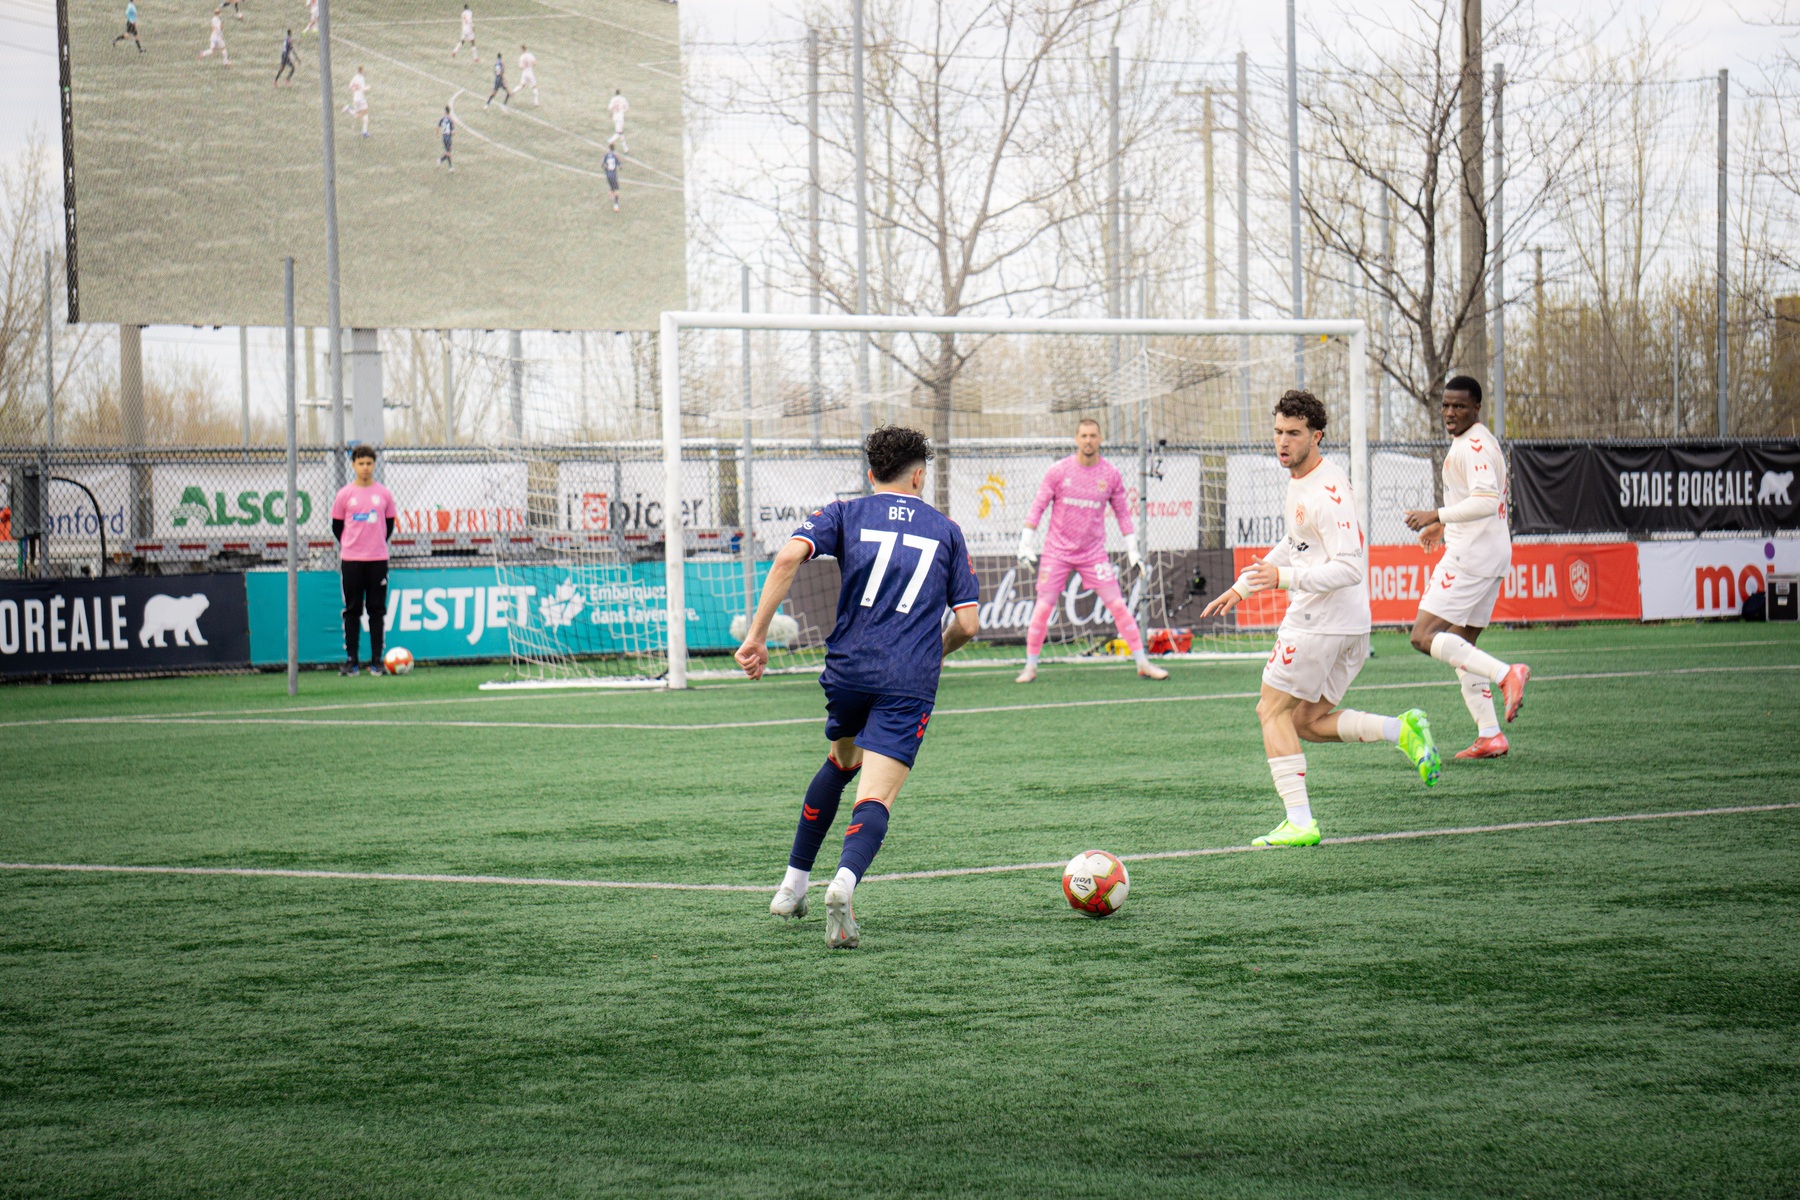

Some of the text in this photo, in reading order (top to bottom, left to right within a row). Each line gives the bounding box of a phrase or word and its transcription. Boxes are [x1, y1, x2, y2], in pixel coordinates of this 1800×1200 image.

[1619, 468, 1753, 507] STADE BORÉALE
[170, 486, 312, 527] ALSCO
[760, 506, 823, 521] EVAN
[888, 506, 916, 522] BEY
[860, 528, 940, 614] 77
[1504, 564, 1528, 599] DE
[1532, 563, 1558, 598] LA
